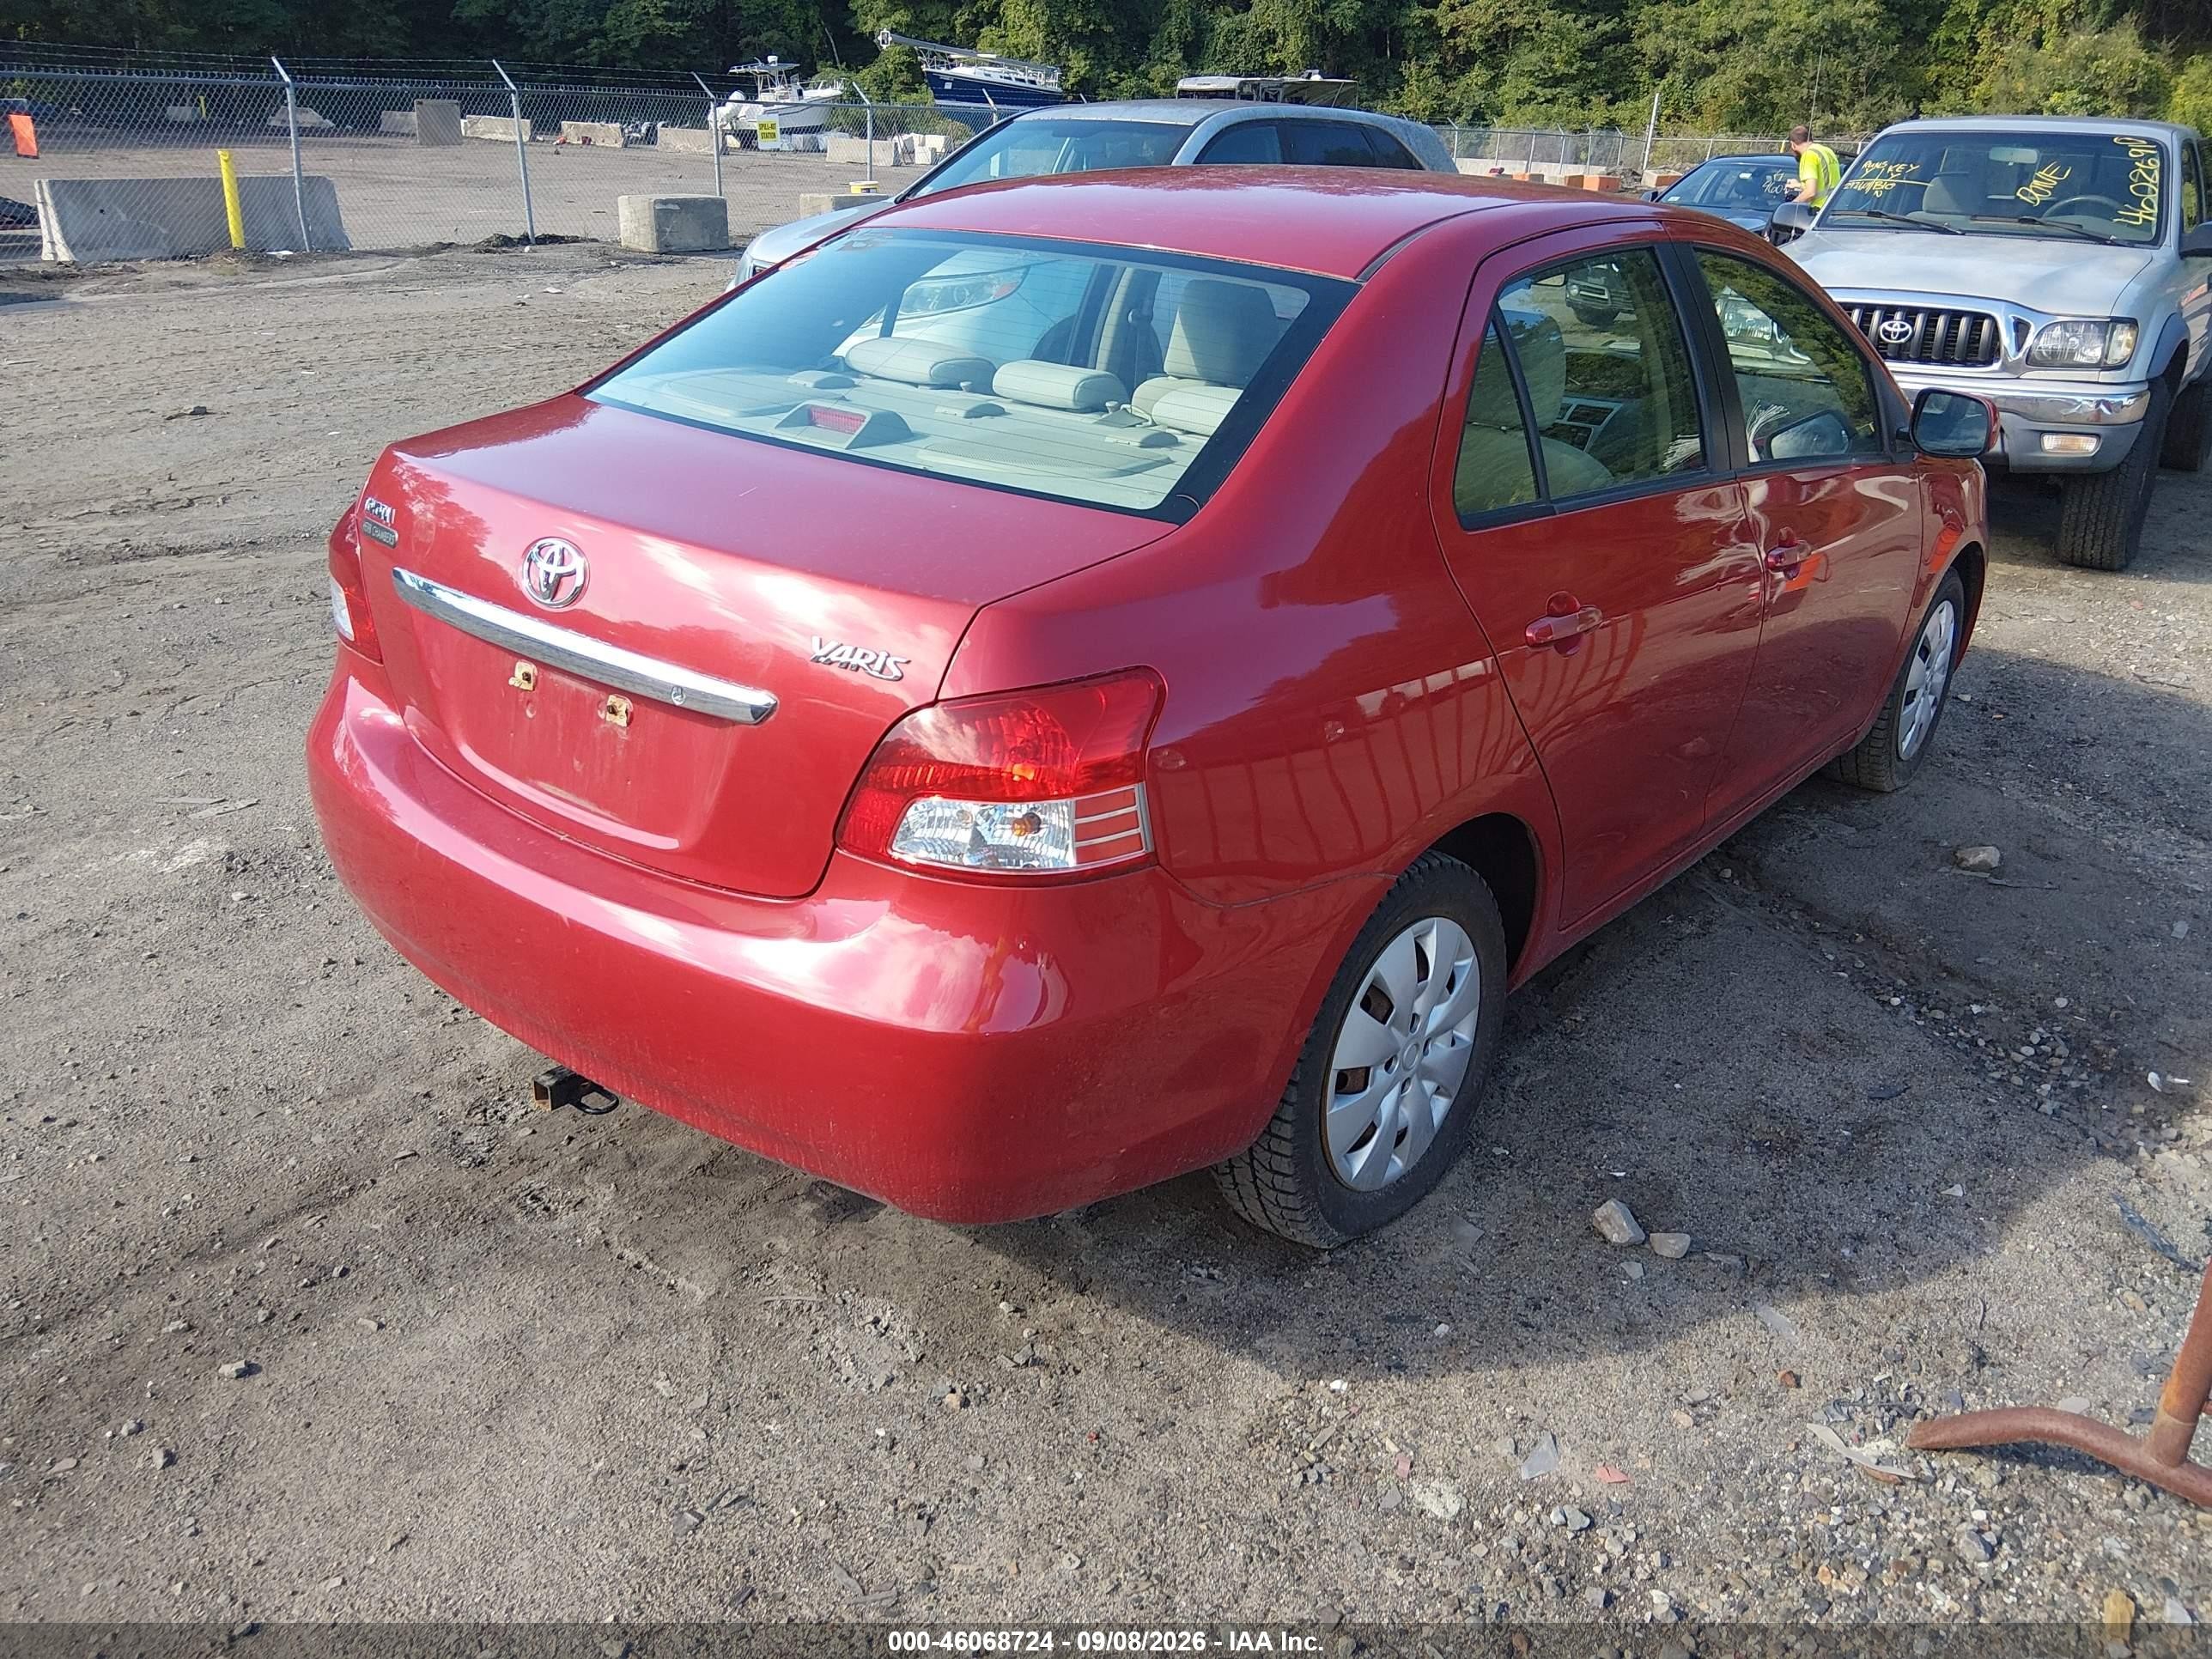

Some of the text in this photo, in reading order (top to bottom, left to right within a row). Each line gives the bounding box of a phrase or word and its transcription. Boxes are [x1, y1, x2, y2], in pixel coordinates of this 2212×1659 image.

[1887, 163, 1920, 173] KEY
[2016, 161, 2072, 207] DONE
[811, 635, 912, 682] YARIS
